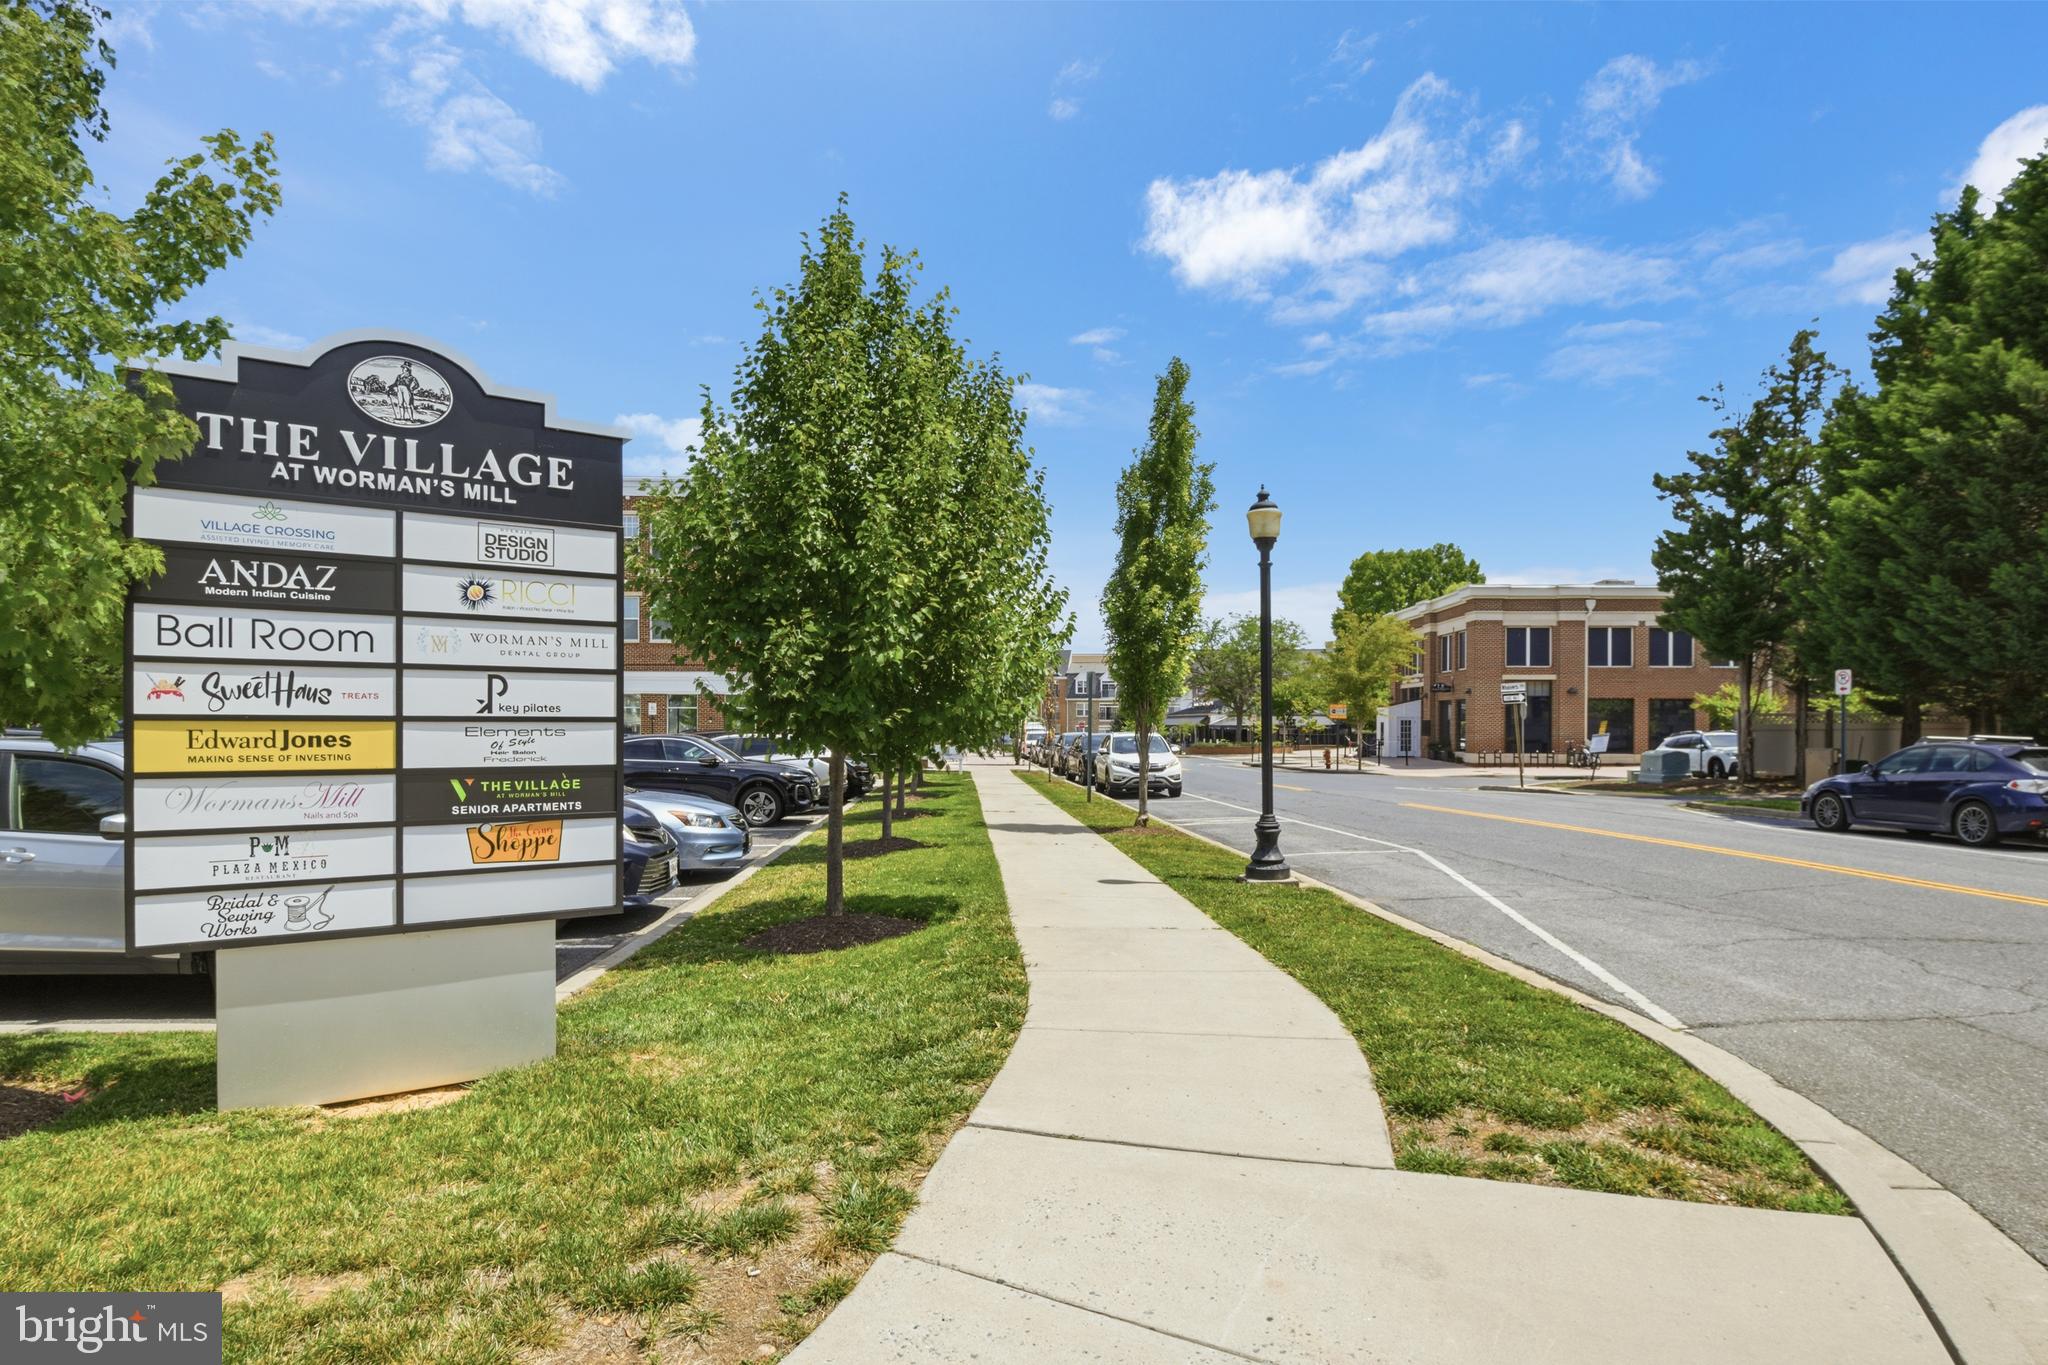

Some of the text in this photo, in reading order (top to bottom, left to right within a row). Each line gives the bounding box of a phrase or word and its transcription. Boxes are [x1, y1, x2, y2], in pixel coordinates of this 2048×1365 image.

[196, 411, 575, 490] THE VILLAGE
[271, 461, 517, 504] AT WORMAN'S MILL
[200, 519, 336, 540] VILLAGE CROSSING
[200, 534, 240, 543] ASSISTED
[242, 537, 270, 545] LIVING
[277, 540, 312, 549] MEMORY
[485, 533, 548, 550] DESIGN
[484, 546, 548, 562] STUDIO
[198, 558, 338, 591] ANDAZ
[204, 586, 331, 601] Modern Indian Cuisine
[502, 579, 575, 606] RICCI
[157, 614, 374, 653] Ball Room
[470, 632, 609, 649] WORMAN'S MILL
[341, 692, 380, 700] TREATS
[499, 703, 561, 714] key pilates
[465, 726, 566, 737] Elements
[186, 729, 352, 751] Edward Jones
[490, 737, 535, 750] Of Style
[187, 753, 352, 763] MAKING SENSE OF INVESTING
[480, 779, 581, 792] THE VILLAGE
[298, 781, 365, 809] Mill
[343, 811, 358, 820] Spa
[451, 801, 582, 815] SENIOR APARTMENTS
[475, 823, 557, 861] Shoppe
[212, 859, 327, 877] PLAZA MEXICO
[207, 892, 279, 911] Bridal &
[217, 908, 276, 923] Sewing
[200, 922, 258, 938] Works
